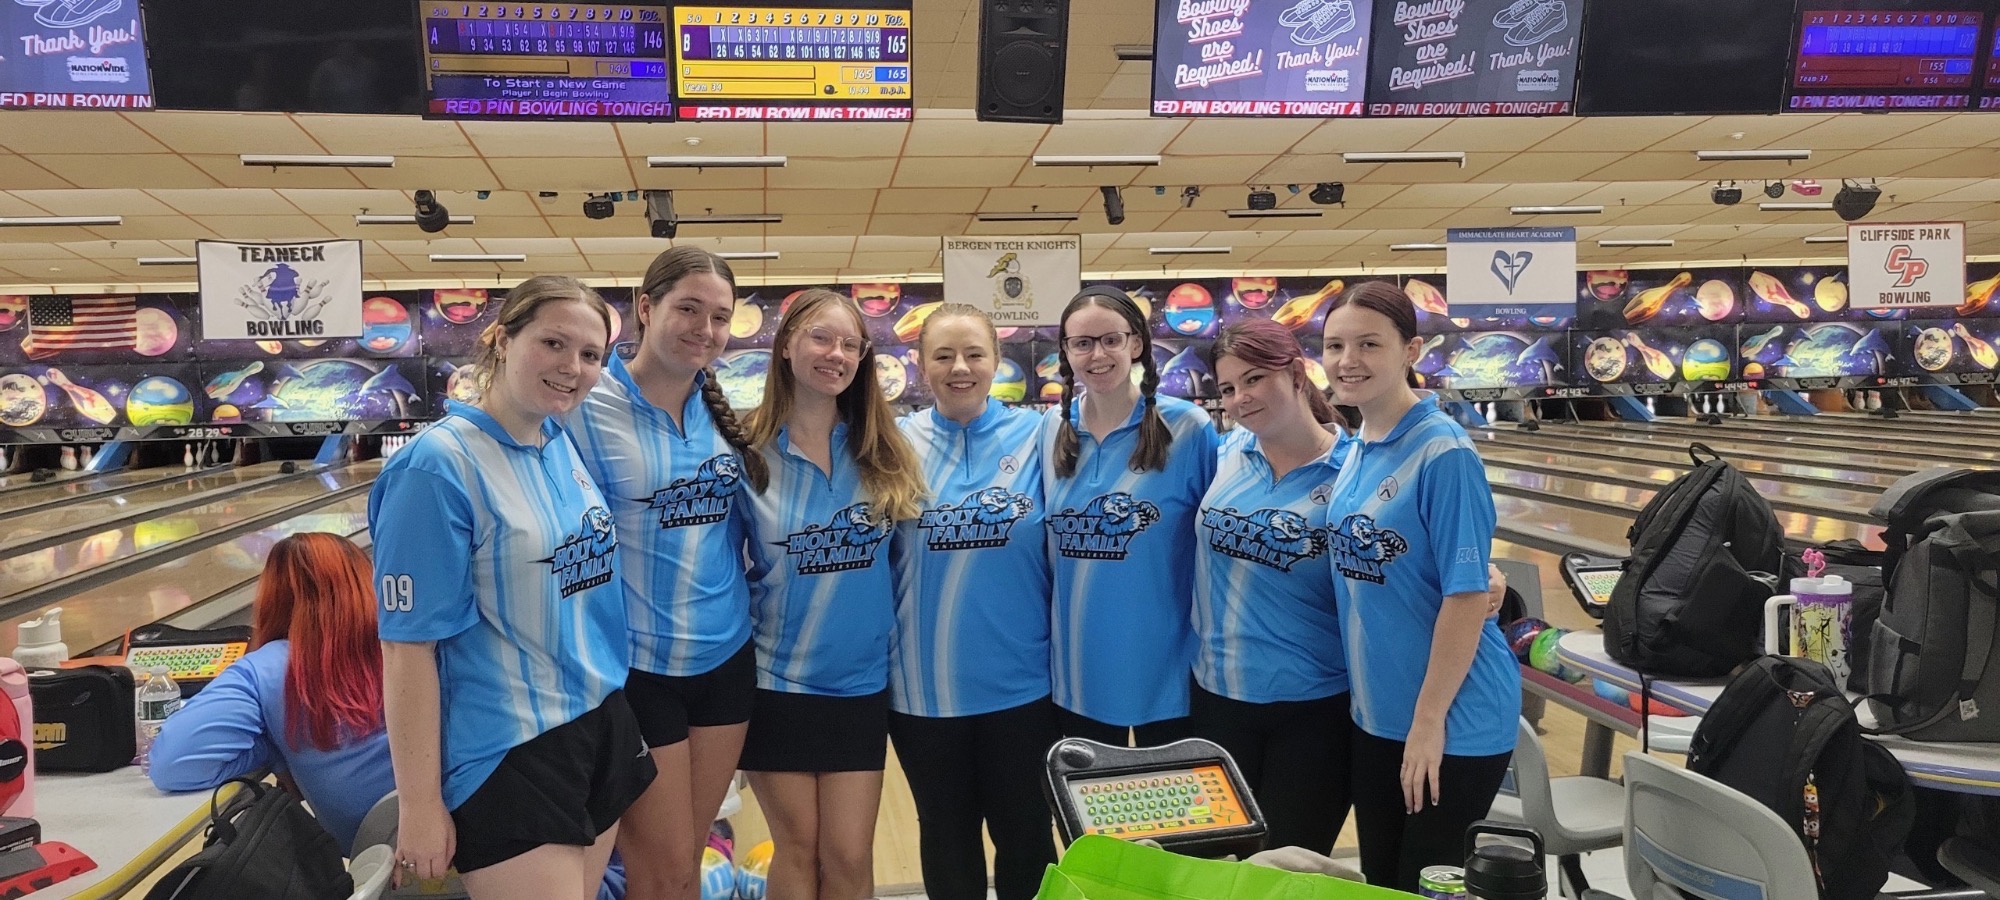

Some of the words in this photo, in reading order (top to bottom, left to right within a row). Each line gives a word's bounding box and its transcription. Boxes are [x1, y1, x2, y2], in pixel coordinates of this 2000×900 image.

[20, 29, 84, 55] Thank
[89, 19, 136, 54] You!
[1188, 17, 1243, 39] Shoes
[1404, 19, 1458, 41] Shoes
[430, 27, 438, 45] A
[643, 30, 662, 49] 146
[683, 33, 691, 51] B
[887, 35, 906, 54] 165
[717, 44, 727, 58] 26
[734, 45, 745, 58] 45
[751, 45, 761, 58] 54
[769, 45, 779, 58] 62
[785, 45, 796, 59] 82
[801, 45, 813, 59] 101
[818, 46, 830, 59] 118
[834, 46, 846, 59] 127
[851, 46, 863, 59] 146
[867, 46, 880, 60] 165
[1201, 40, 1234, 59] are
[1277, 46, 1322, 70] Thank
[1325, 37, 1363, 67] You!
[1416, 42, 1447, 61] are
[1490, 47, 1533, 70] Thank
[1537, 37, 1574, 67] You!
[645, 63, 664, 74] 146
[853, 69, 873, 79] 165
[888, 69, 907, 79] 165
[1174, 49, 1262, 86] Required!
[1389, 51, 1475, 88] Required!
[483, 78, 500, 88] To
[506, 78, 540, 88] Start
[560, 79, 586, 89] New
[592, 80, 626, 89] Game
[33, 93, 66, 107] PIN
[502, 89, 532, 97] Player
[543, 90, 568, 98] Begin
[572, 90, 609, 98] Bowling
[1802, 96, 1824, 107] PIN
[1826, 96, 1885, 107] BOWLING
[1889, 96, 1942, 107] TONIGHT
[445, 100, 480, 114] RED
[486, 101, 514, 115] PIN
[518, 101, 598, 116] BOWLING
[603, 102, 671, 116] TONIGHT
[696, 107, 731, 119] RED
[735, 107, 763, 119] PIN
[766, 107, 843, 119] BOWLING
[1181, 101, 1205, 114] PIN
[1208, 101, 1280, 114] BOWLING
[1284, 102, 1350, 115] TONIGHT
[1394, 104, 1420, 115] PIN
[1422, 103, 1490, 115] BOWLING
[1495, 102, 1555, 115] TONIGHT
[1860, 229, 1915, 241] CLIFFSIDE
[1920, 228, 1951, 240] PARK
[237, 246, 325, 263] TEANECK
[948, 241, 992, 250] BERGEN
[995, 241, 1023, 250] TECH
[1027, 240, 1076, 250] KNIGHTS
[1884, 245, 1929, 288] CP
[1879, 291, 1931, 304] BOWLING
[987, 311, 1039, 320] BOWLING
[1495, 307, 1527, 315] BOWLING
[246, 319, 324, 336] BOWLING
[189, 428, 203, 438] 28
[206, 428, 219, 438] 29
[652, 481, 713, 508] HOLY
[920, 508, 978, 527] HOLY
[1051, 516, 1100, 534] HOLY
[1198, 509, 1264, 540] HOLY
[786, 528, 848, 553] HOLY
[929, 523, 1011, 543] FAMILY
[934, 540, 1001, 550] UNIVERSITY
[1060, 533, 1131, 553] FAMILY
[1211, 528, 1296, 569] FAMILY
[1328, 531, 1352, 555] OLY
[553, 538, 592, 572] HOLY
[800, 542, 878, 569] FAMILY
[561, 552, 613, 589] FAMILY
[803, 561, 868, 573] UNIVERSITY
[382, 574, 414, 612] 09
